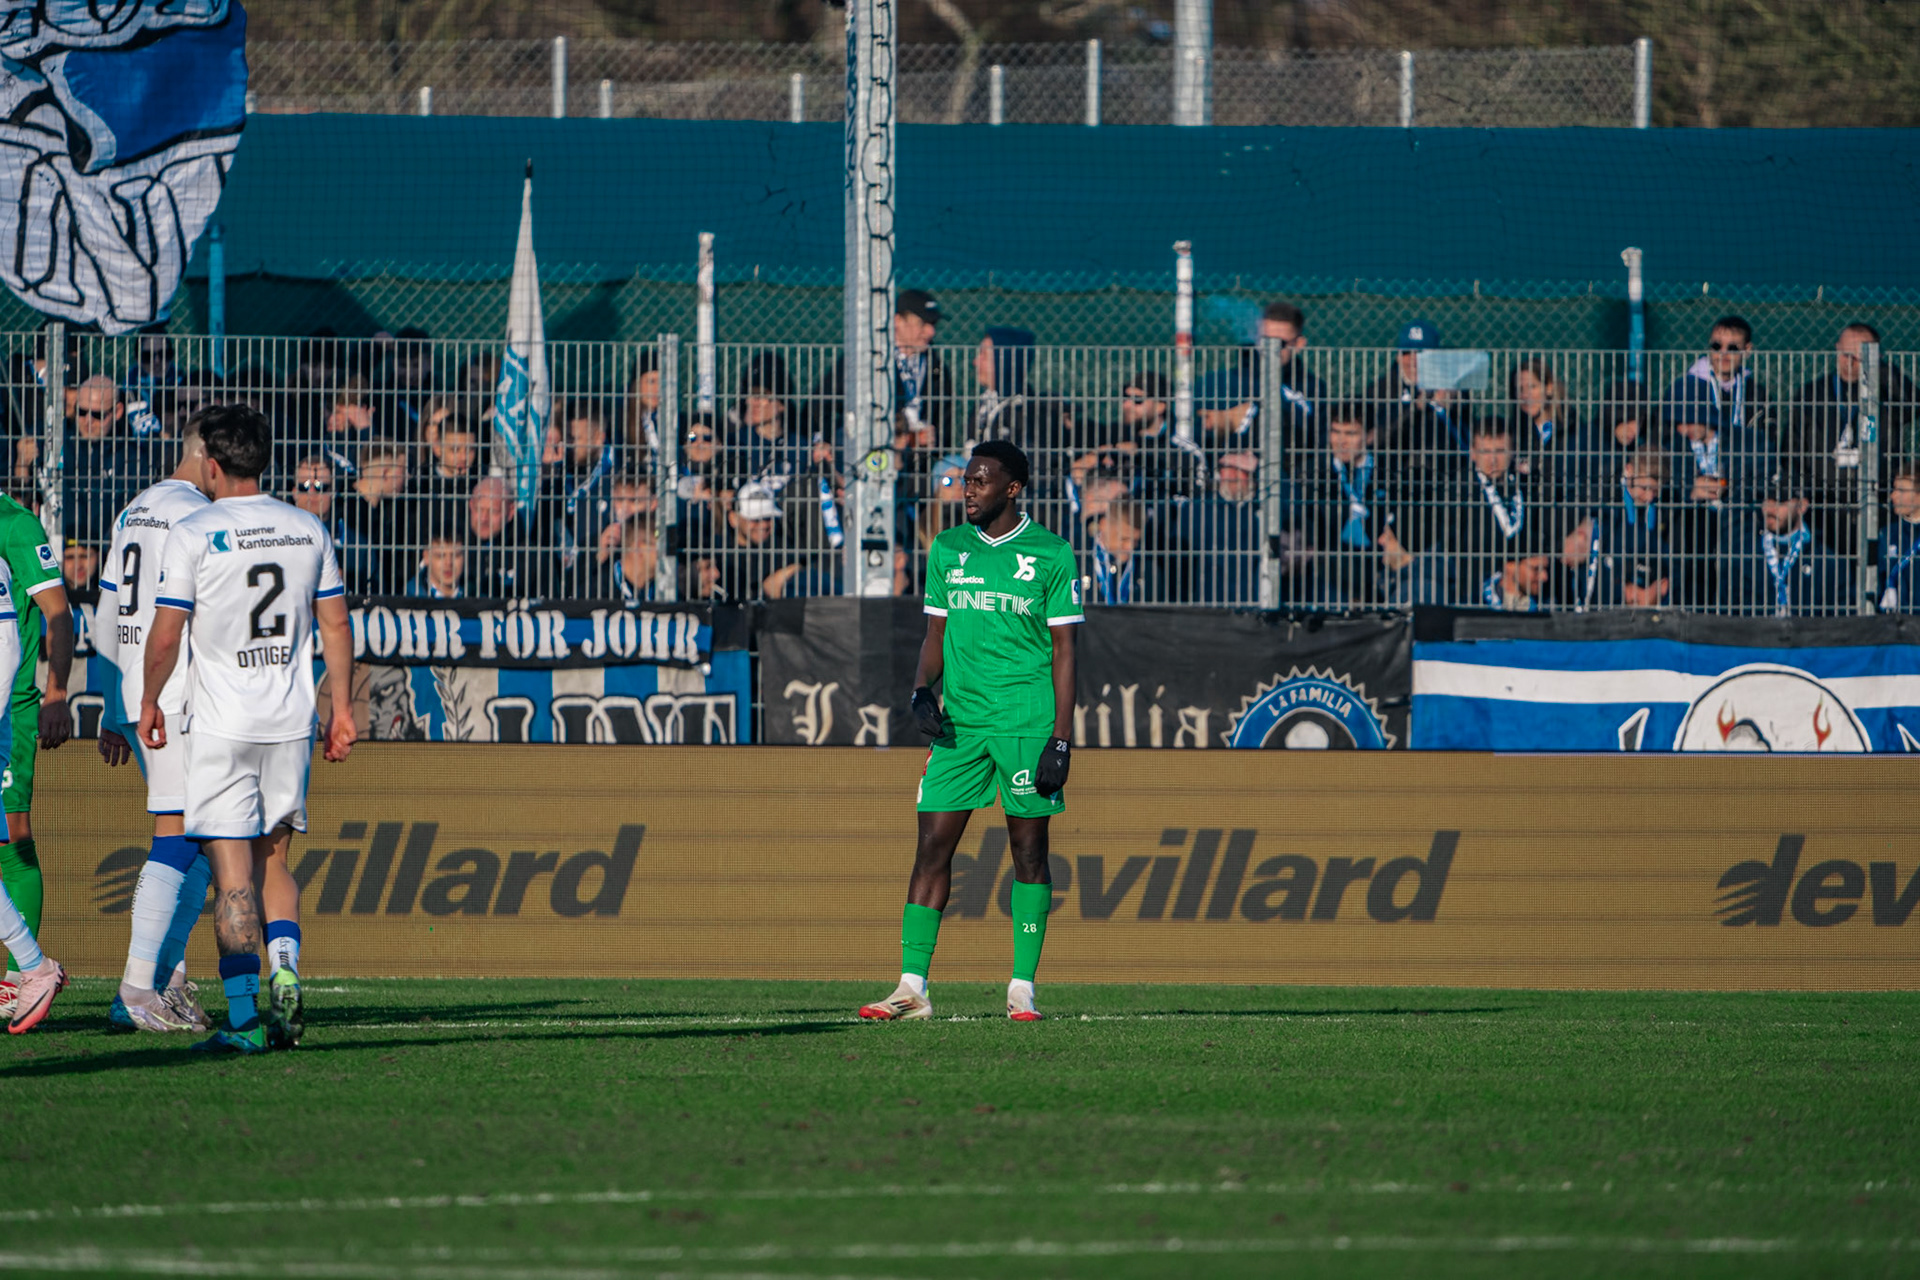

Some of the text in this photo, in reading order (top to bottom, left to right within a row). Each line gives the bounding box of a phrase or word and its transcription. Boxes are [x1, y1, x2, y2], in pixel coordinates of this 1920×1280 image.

[235, 526, 276, 538] Luzerner
[238, 534, 314, 551] Kantonalbank
[119, 543, 142, 616] 9
[247, 562, 286, 641] 2
[947, 590, 1035, 617] KINETIK
[478, 598, 570, 659] FÖR
[580, 608, 700, 664] JOHR
[1268, 686, 1352, 719] LA FAMILIA
[1055, 740, 1067, 752] 28
[1012, 769, 1032, 786] GL
[1022, 922, 1037, 933] 28
